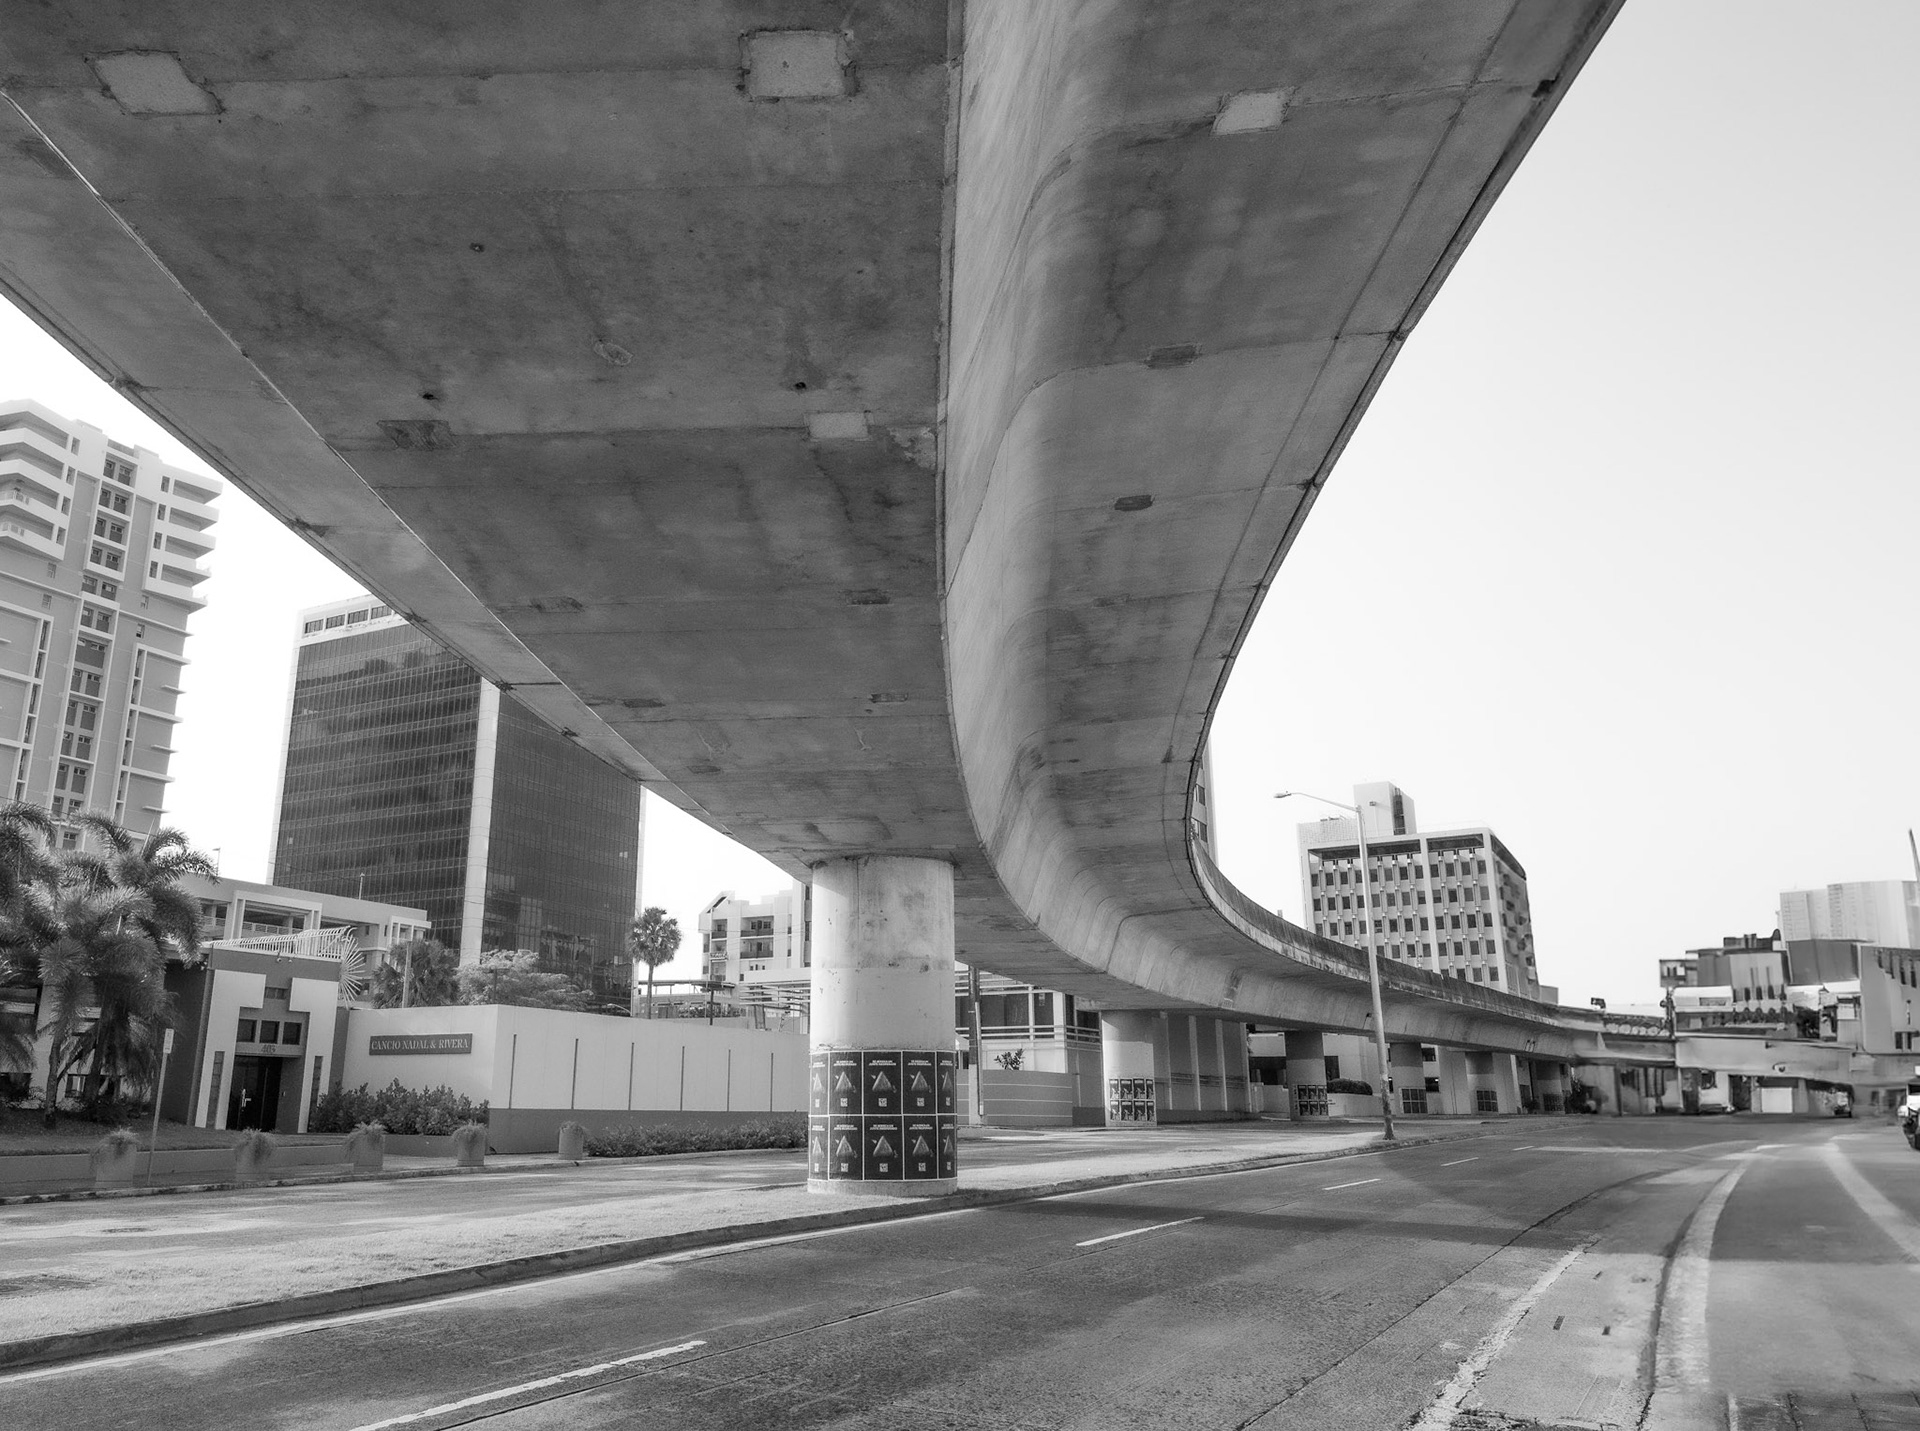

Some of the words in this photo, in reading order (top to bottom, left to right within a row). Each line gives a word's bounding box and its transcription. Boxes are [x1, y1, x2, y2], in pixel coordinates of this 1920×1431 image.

[372, 1040, 401, 1050] CANCIO
[403, 1040, 429, 1049] NADAL
[438, 1039, 469, 1049] RIVERA
